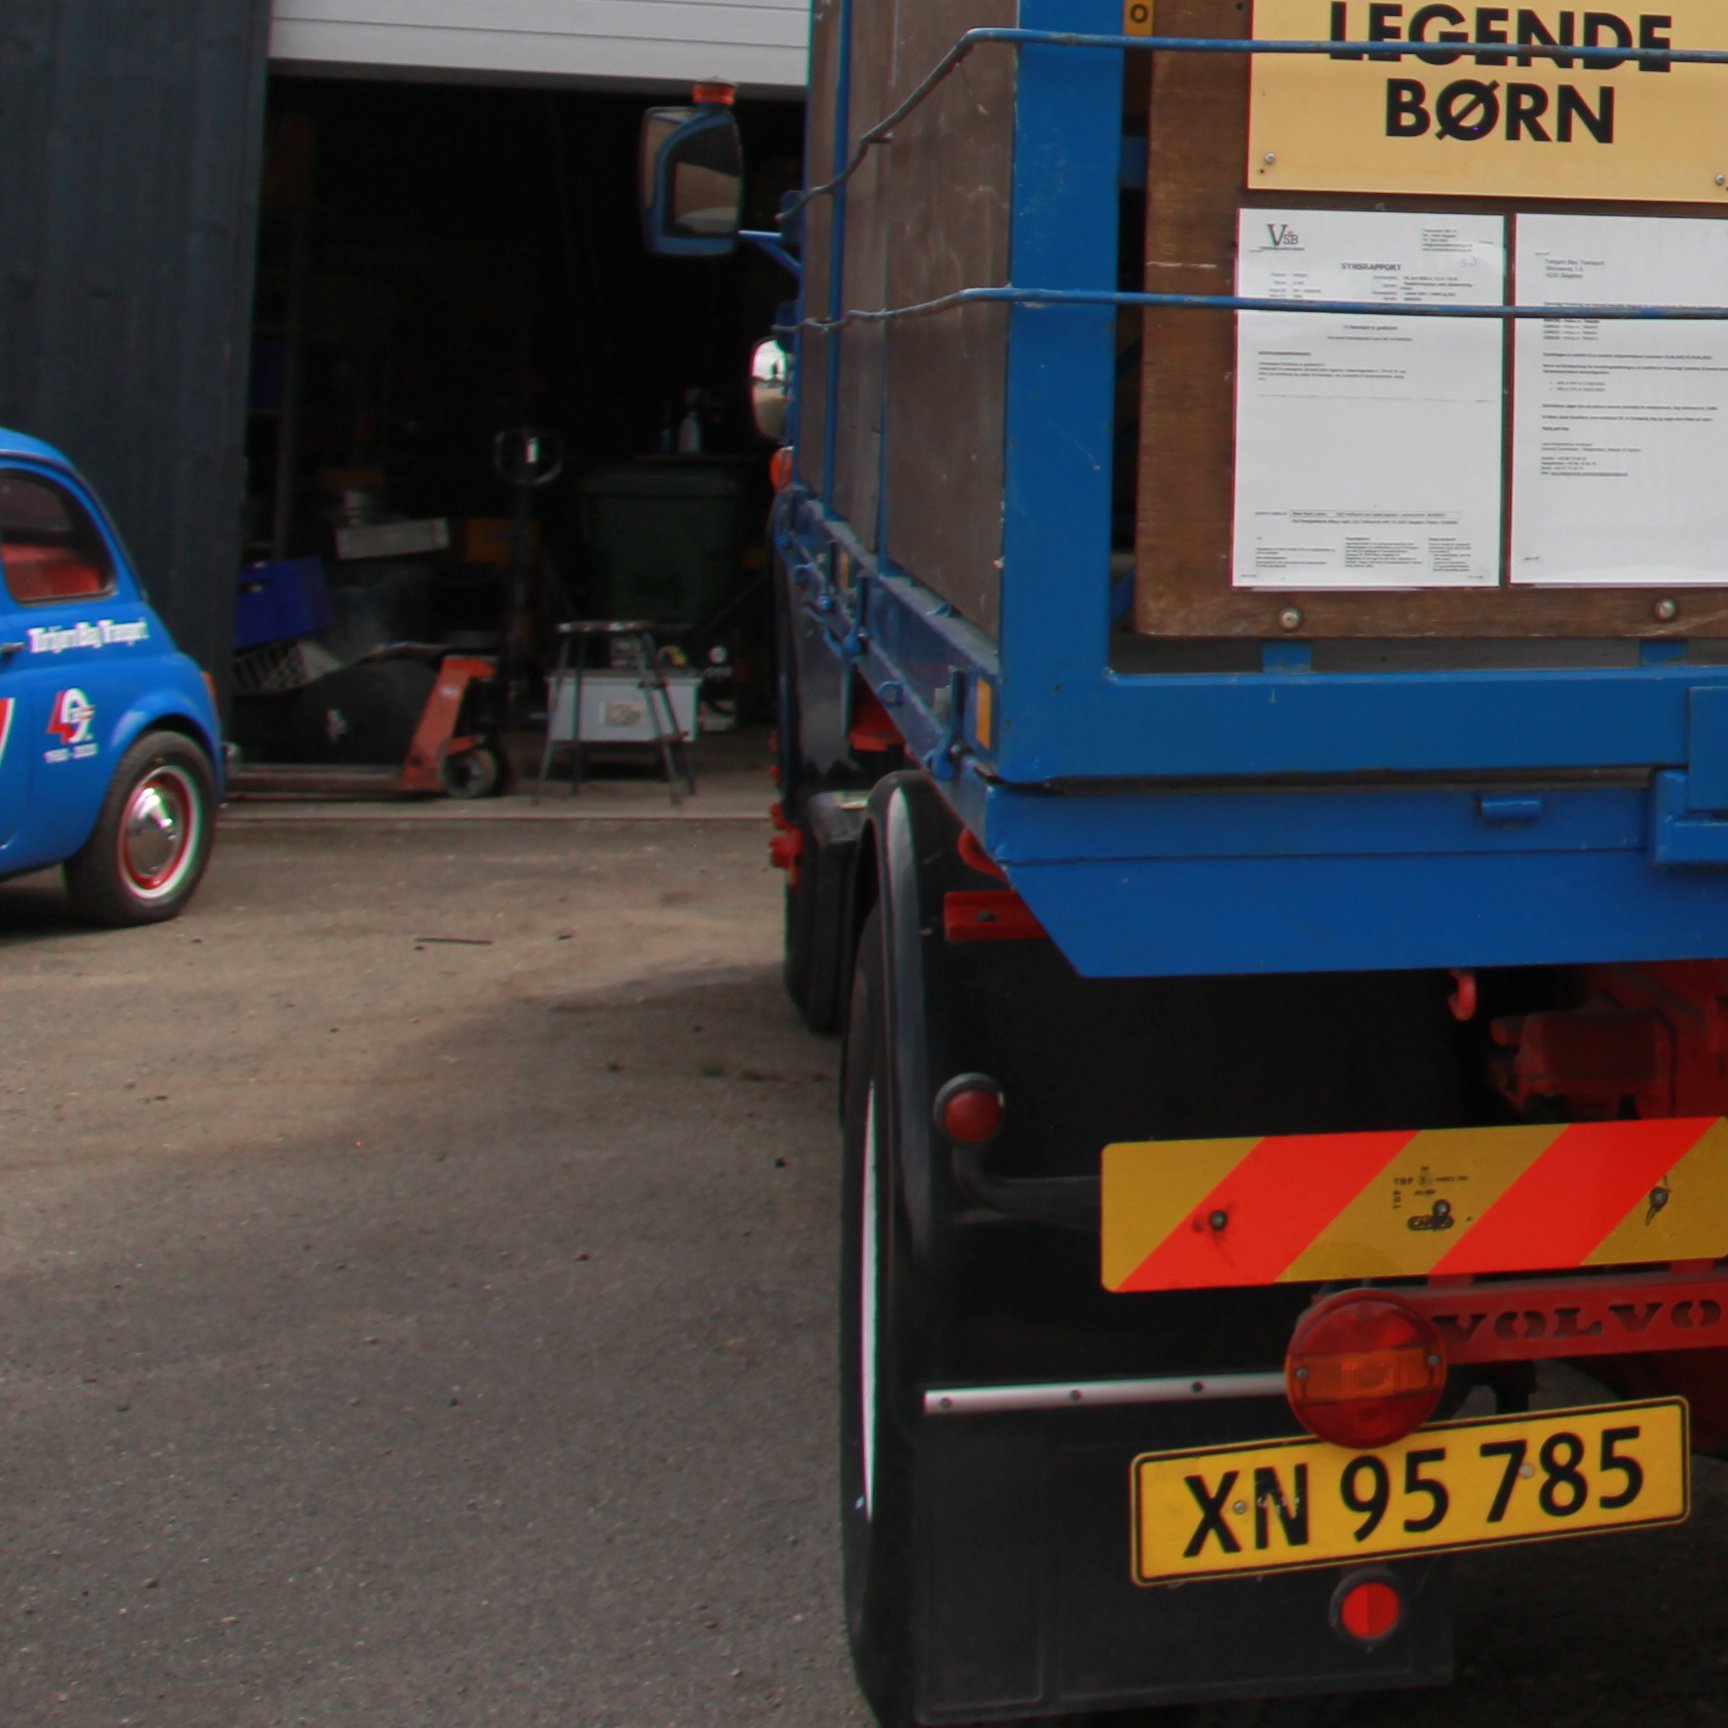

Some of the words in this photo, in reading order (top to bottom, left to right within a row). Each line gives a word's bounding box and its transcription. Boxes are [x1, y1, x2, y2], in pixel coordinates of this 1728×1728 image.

[1328, 0, 1673, 73] LEGENDE
[1386, 78, 1614, 144] BØRN
[1431, 1298, 1723, 1345] VOLVO
[1183, 1462, 1310, 1559] XN
[1340, 1446, 1449, 1543] 95
[1479, 1425, 1644, 1523] 785
